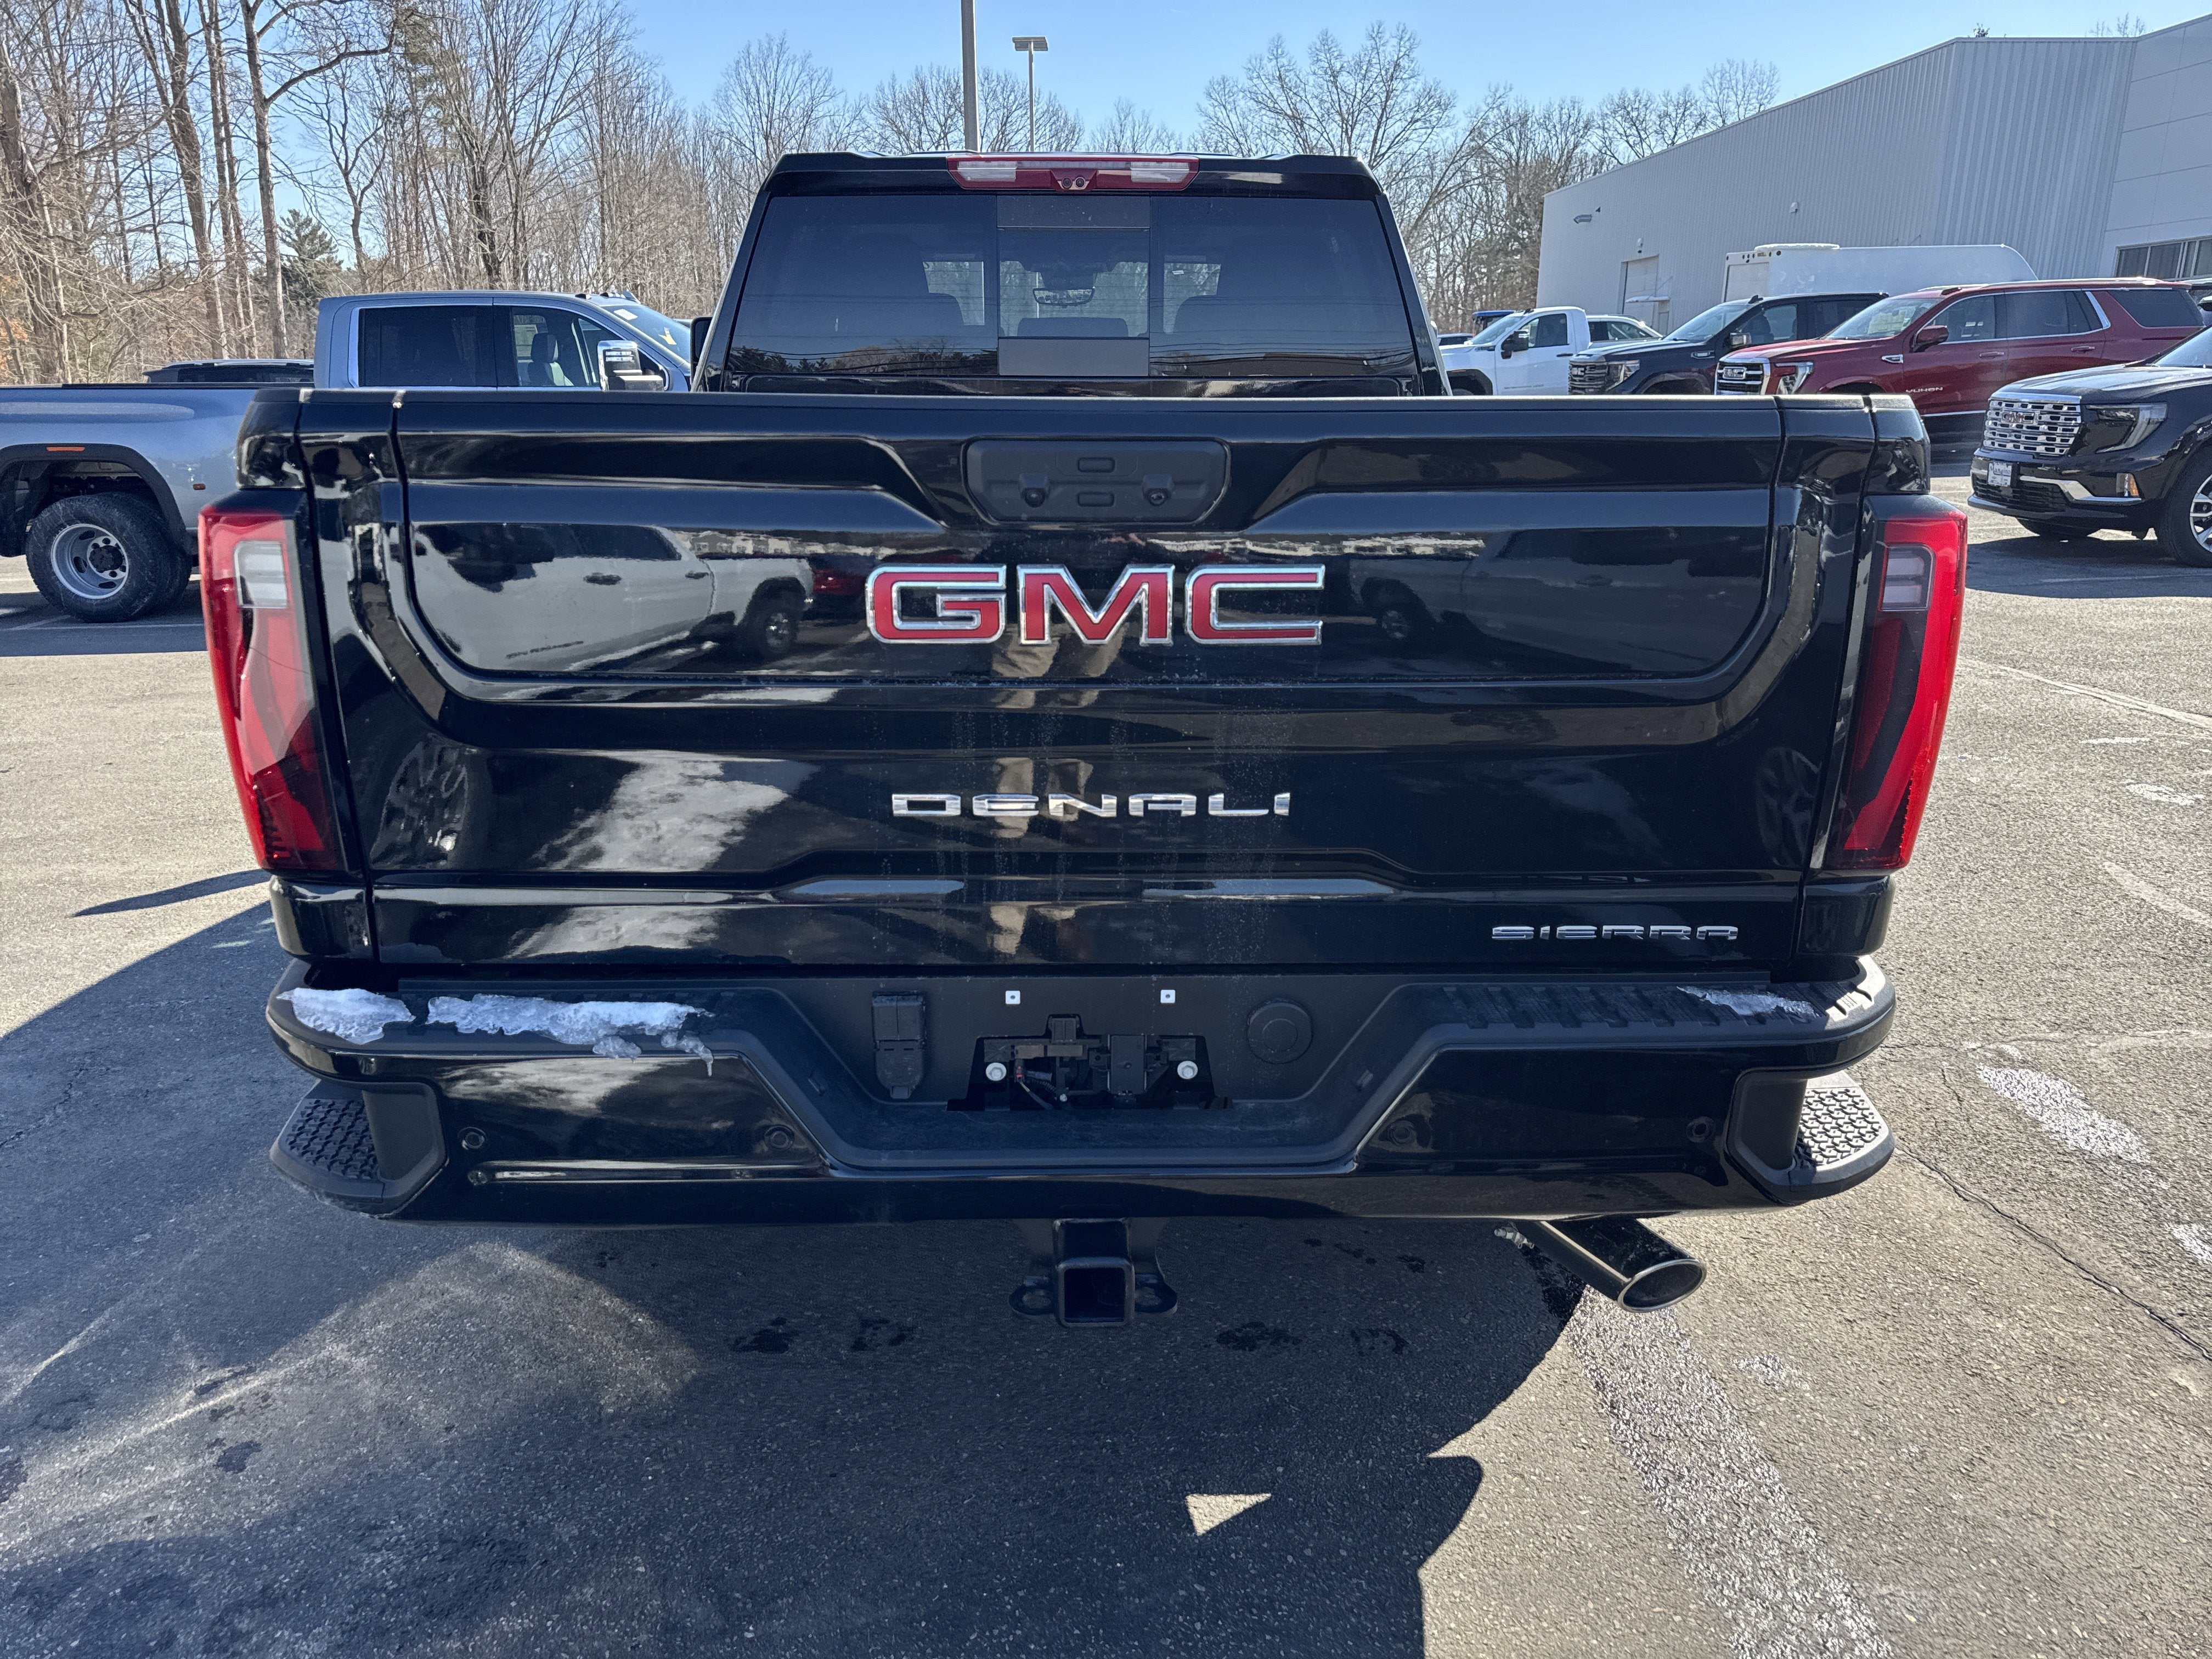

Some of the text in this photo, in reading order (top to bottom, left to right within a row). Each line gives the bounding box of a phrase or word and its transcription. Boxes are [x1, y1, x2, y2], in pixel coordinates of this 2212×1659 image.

[2001, 412, 2035, 424] GMC
[865, 564, 1325, 646] GMC
[892, 792, 1290, 817] DENALI
[1492, 925, 1738, 940] SIERRA
